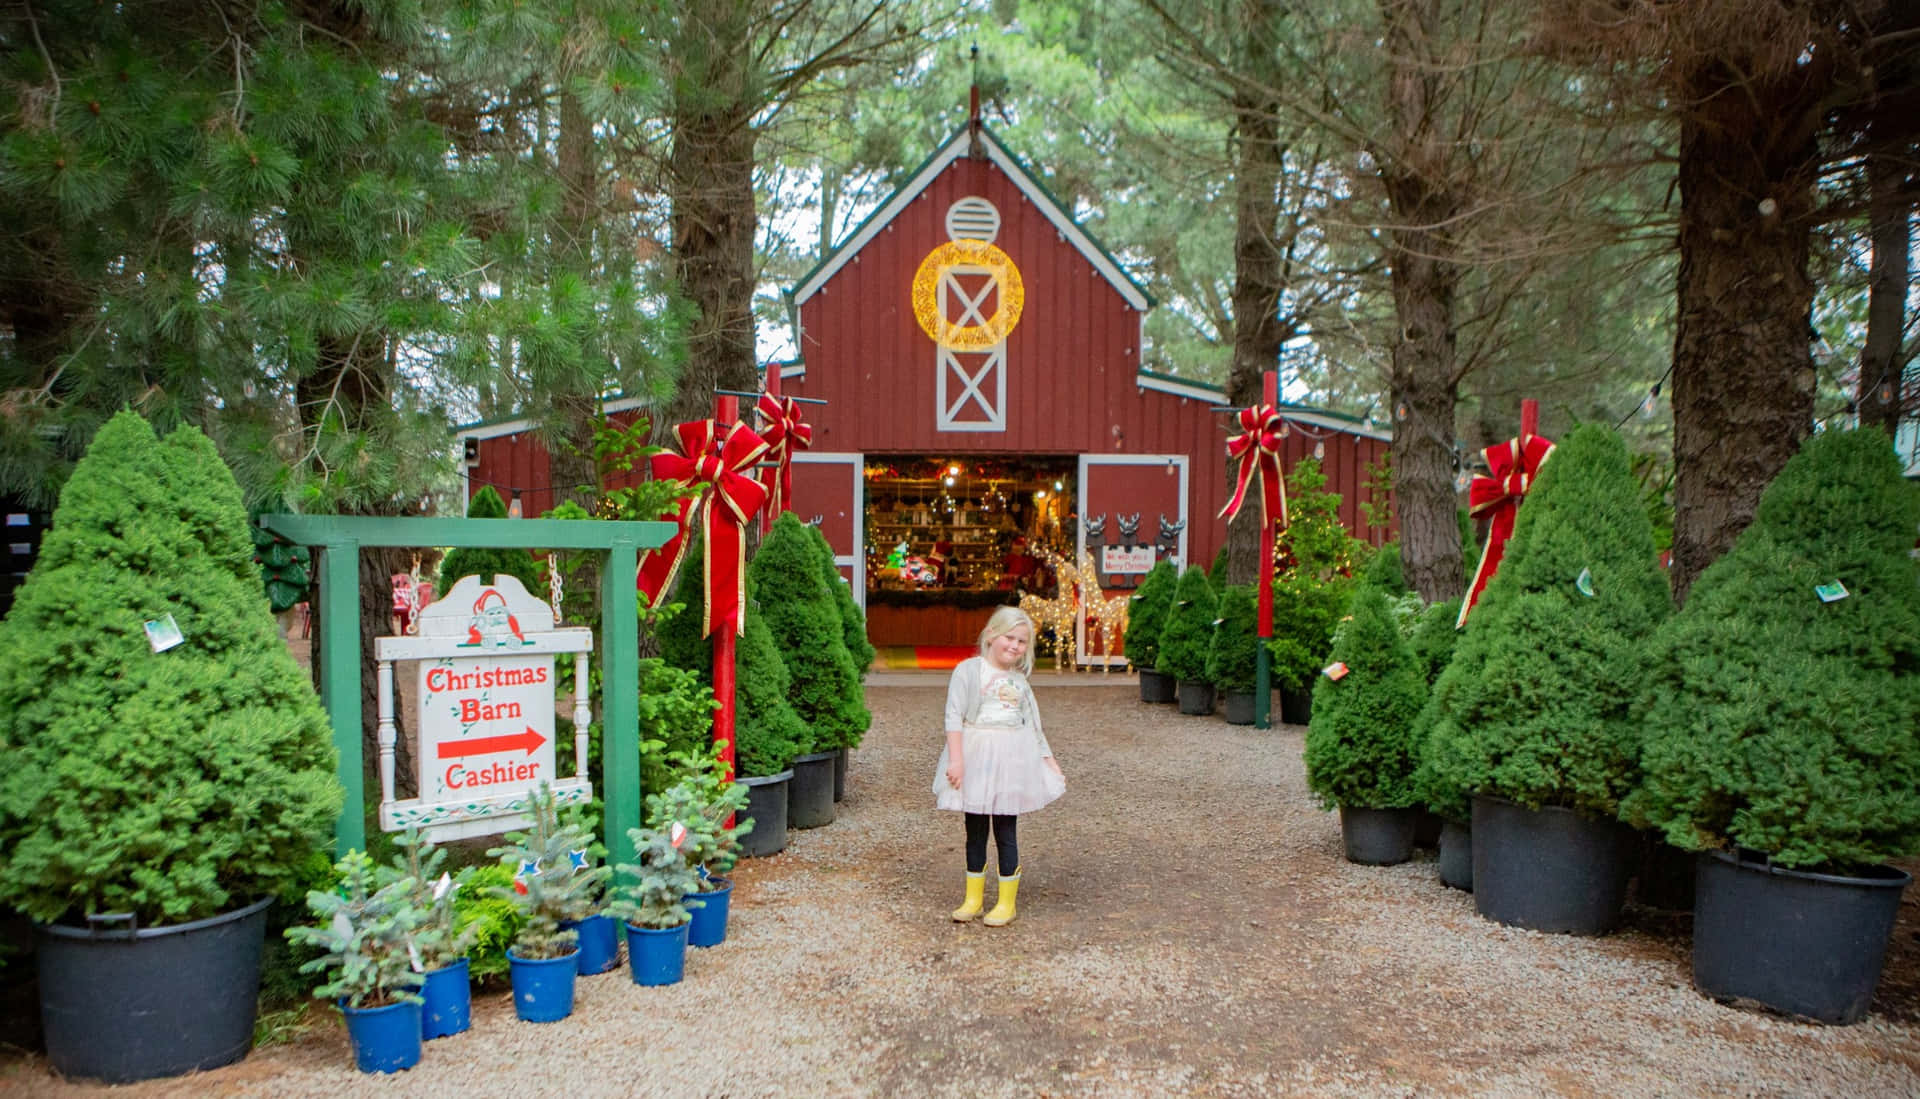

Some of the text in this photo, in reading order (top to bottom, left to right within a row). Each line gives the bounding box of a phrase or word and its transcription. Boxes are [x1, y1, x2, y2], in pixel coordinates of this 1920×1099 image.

[426, 666, 547, 693] Christmas
[460, 699, 522, 723] Barn
[445, 761, 540, 790] Cashier
